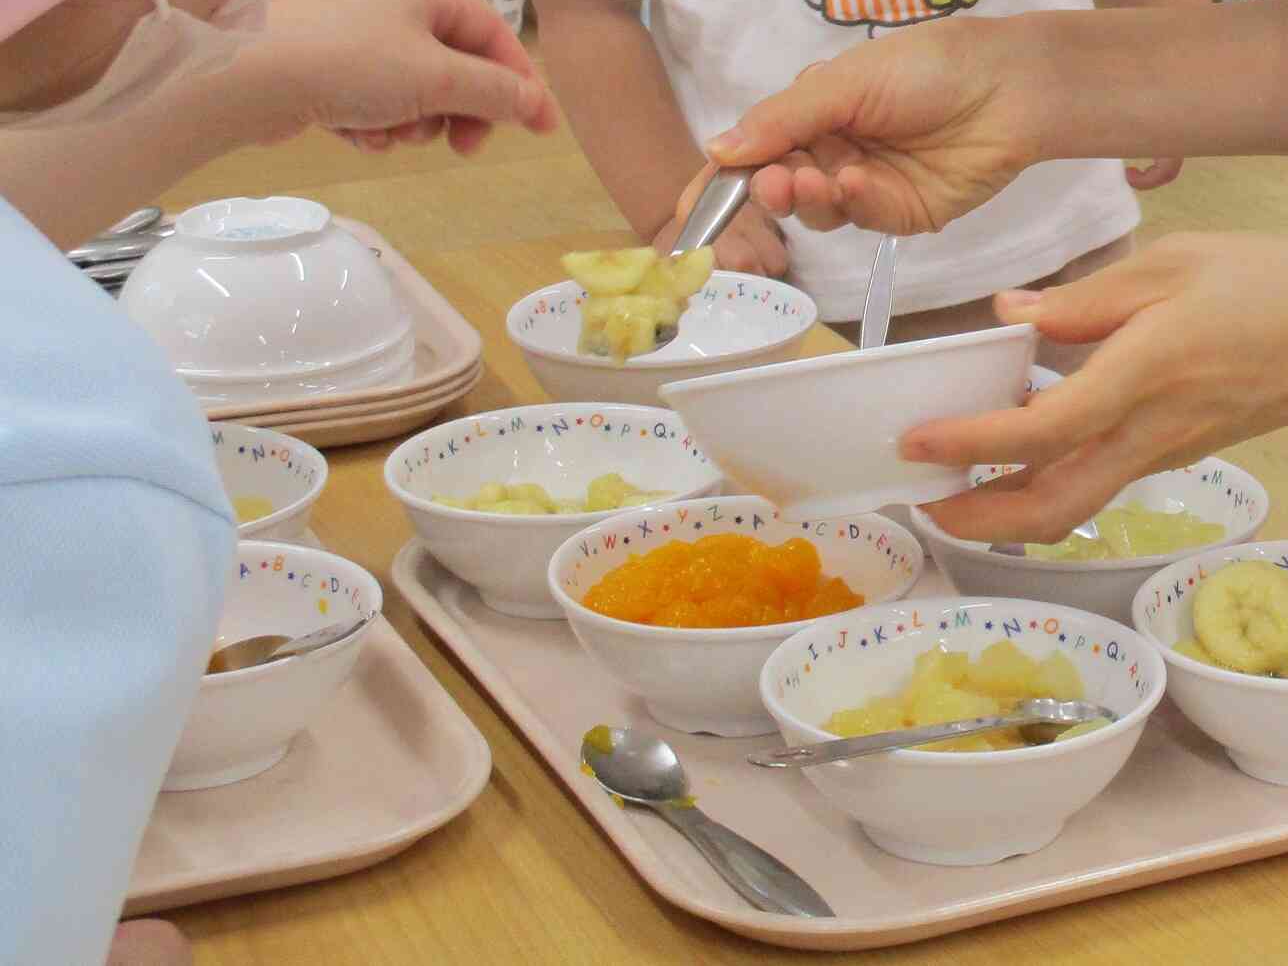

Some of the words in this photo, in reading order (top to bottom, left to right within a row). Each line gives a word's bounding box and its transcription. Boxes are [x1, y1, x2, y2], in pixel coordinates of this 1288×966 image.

[552, 418, 569, 436] N
[590, 413, 604, 428] O
[654, 422, 667, 440] Q
[602, 533, 617, 550] W
[637, 519, 653, 538] X
[849, 524, 860, 539] D
[330, 577, 340, 593] D
[807, 642, 819, 661] I
[838, 630, 849, 649] J
[873, 625, 888, 644] K
[912, 610, 925, 628] L
[954, 610, 971, 628] M
[1003, 618, 1022, 638] N
[1043, 617, 1060, 634] O
[1106, 640, 1119, 661] Q
